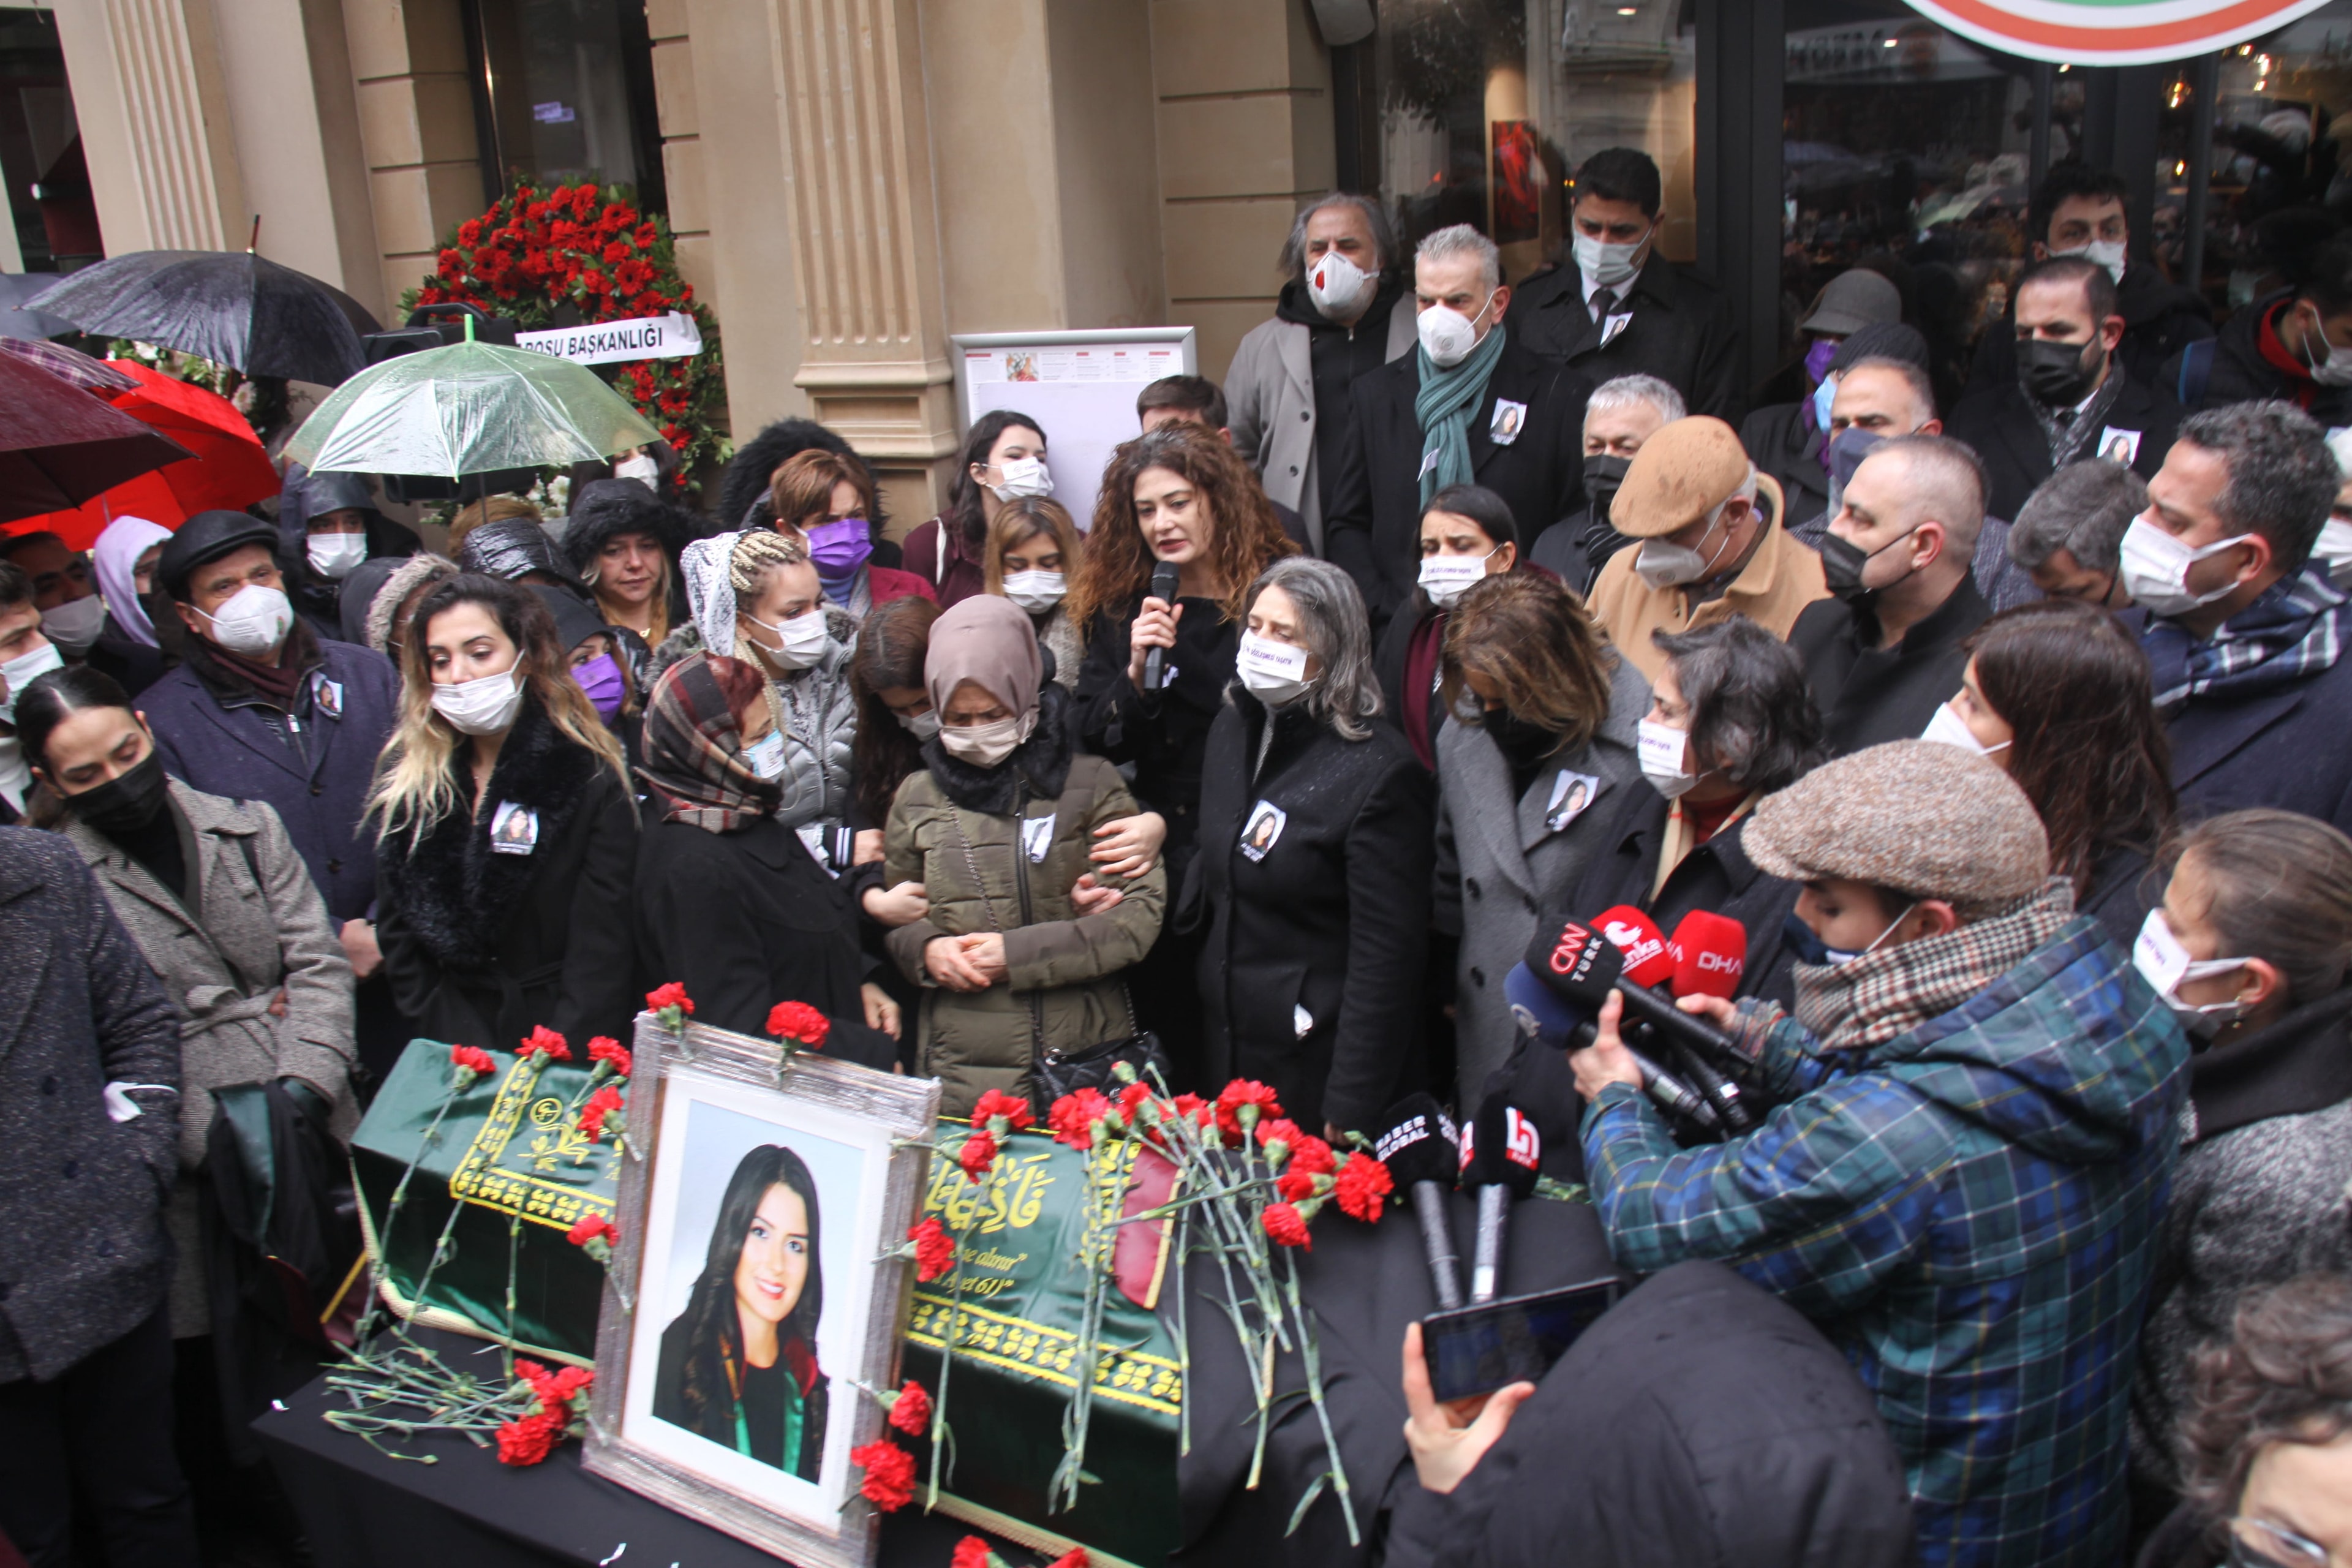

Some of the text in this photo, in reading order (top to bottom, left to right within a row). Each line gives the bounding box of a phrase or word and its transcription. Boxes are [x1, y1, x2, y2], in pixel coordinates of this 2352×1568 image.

[568, 323, 662, 359] BAŞKANLIĞI
[1550, 921, 1590, 974] CNN
[1571, 937, 1603, 982] TÜRK
[1697, 951, 1743, 975] DHA
[1376, 1115, 1426, 1152] HABER
[1377, 1126, 1430, 1163] GLOBAL
